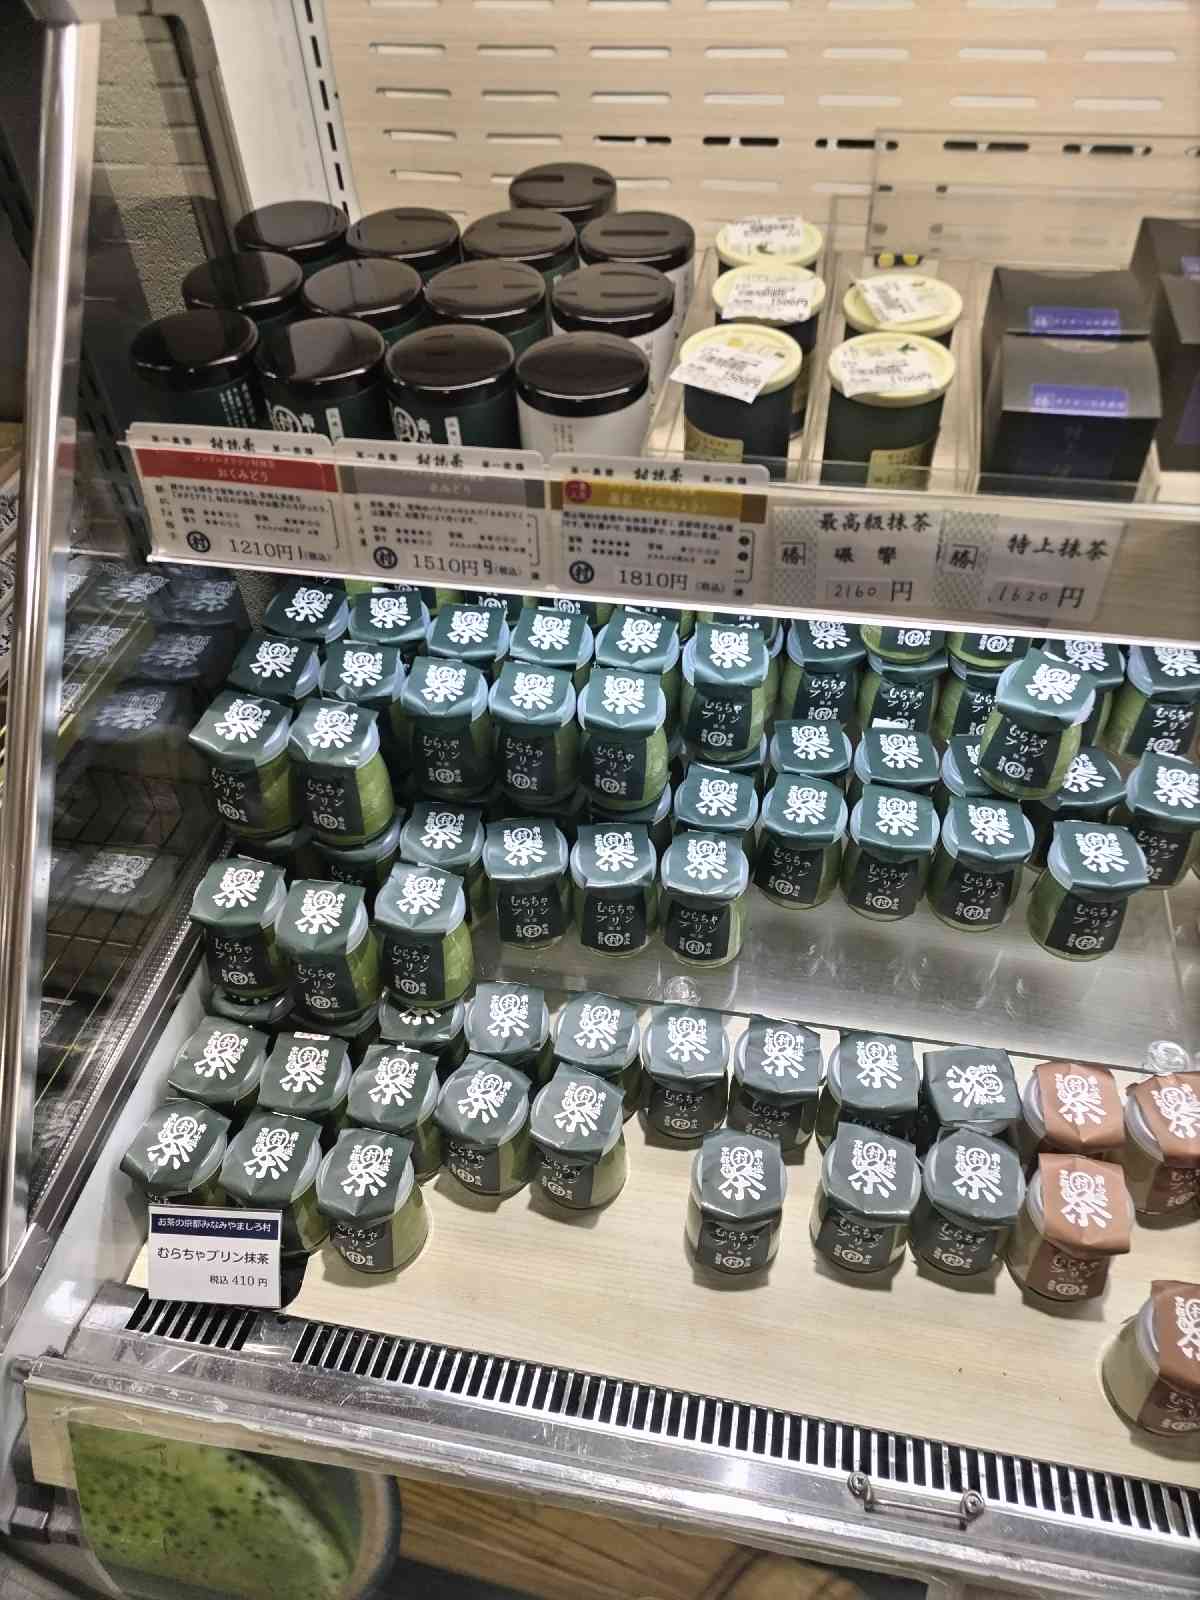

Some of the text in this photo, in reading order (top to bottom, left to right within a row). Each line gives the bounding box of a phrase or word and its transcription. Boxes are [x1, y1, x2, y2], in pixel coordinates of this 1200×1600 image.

[818, 512, 932, 532] 最高級抹茶
[1008, 534, 1108, 562] 特上抹茶
[619, 570, 688, 590] 1810円
[833, 581, 913, 602] 2160 円
[999, 585, 1084, 609] 1620 円
[157, 1217, 271, 1233] お茶の京都みなみやましろ村
[157, 1247, 270, 1265] むらちゃプリン抹茶
[209, 1275, 268, 1287] 税込 410 円
